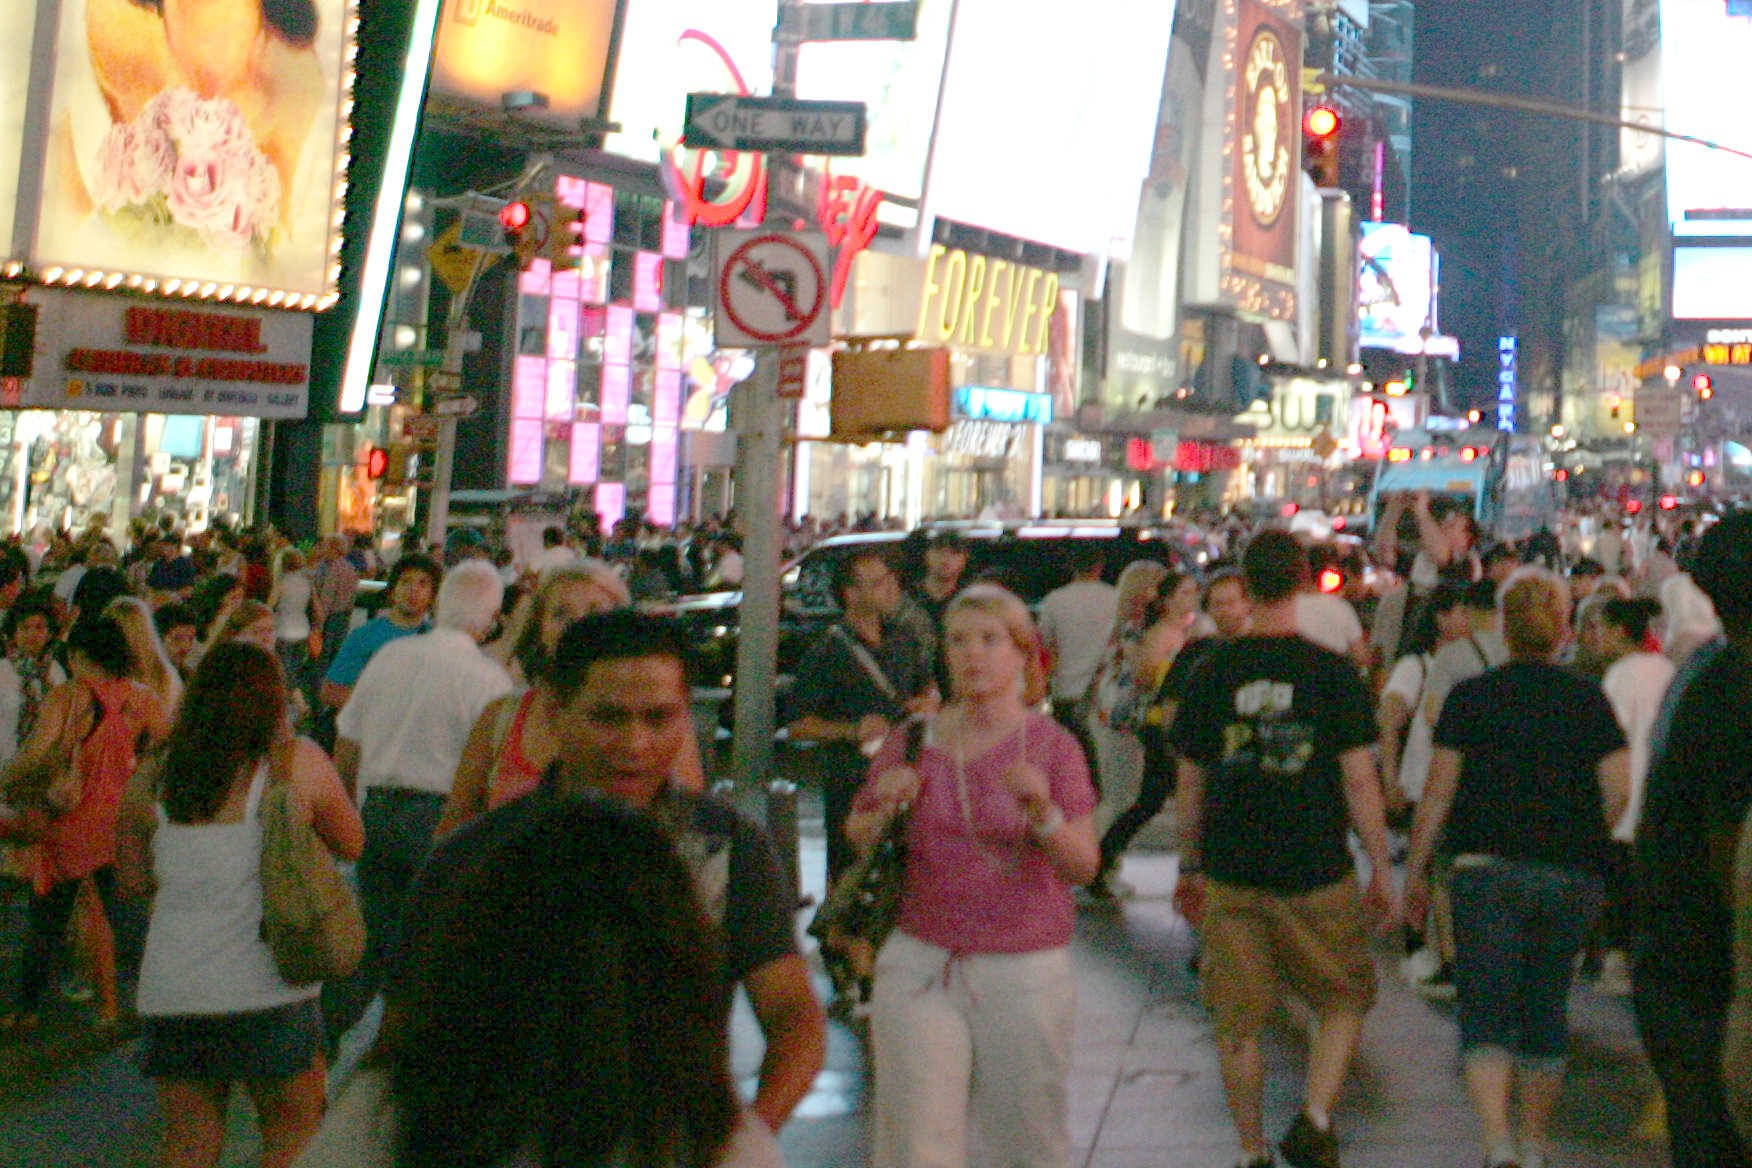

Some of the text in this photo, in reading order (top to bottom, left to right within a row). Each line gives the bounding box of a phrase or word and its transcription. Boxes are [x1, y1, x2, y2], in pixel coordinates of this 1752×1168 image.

[713, 108, 844, 139] ONE WAY
[915, 242, 1060, 354] FOREVER
